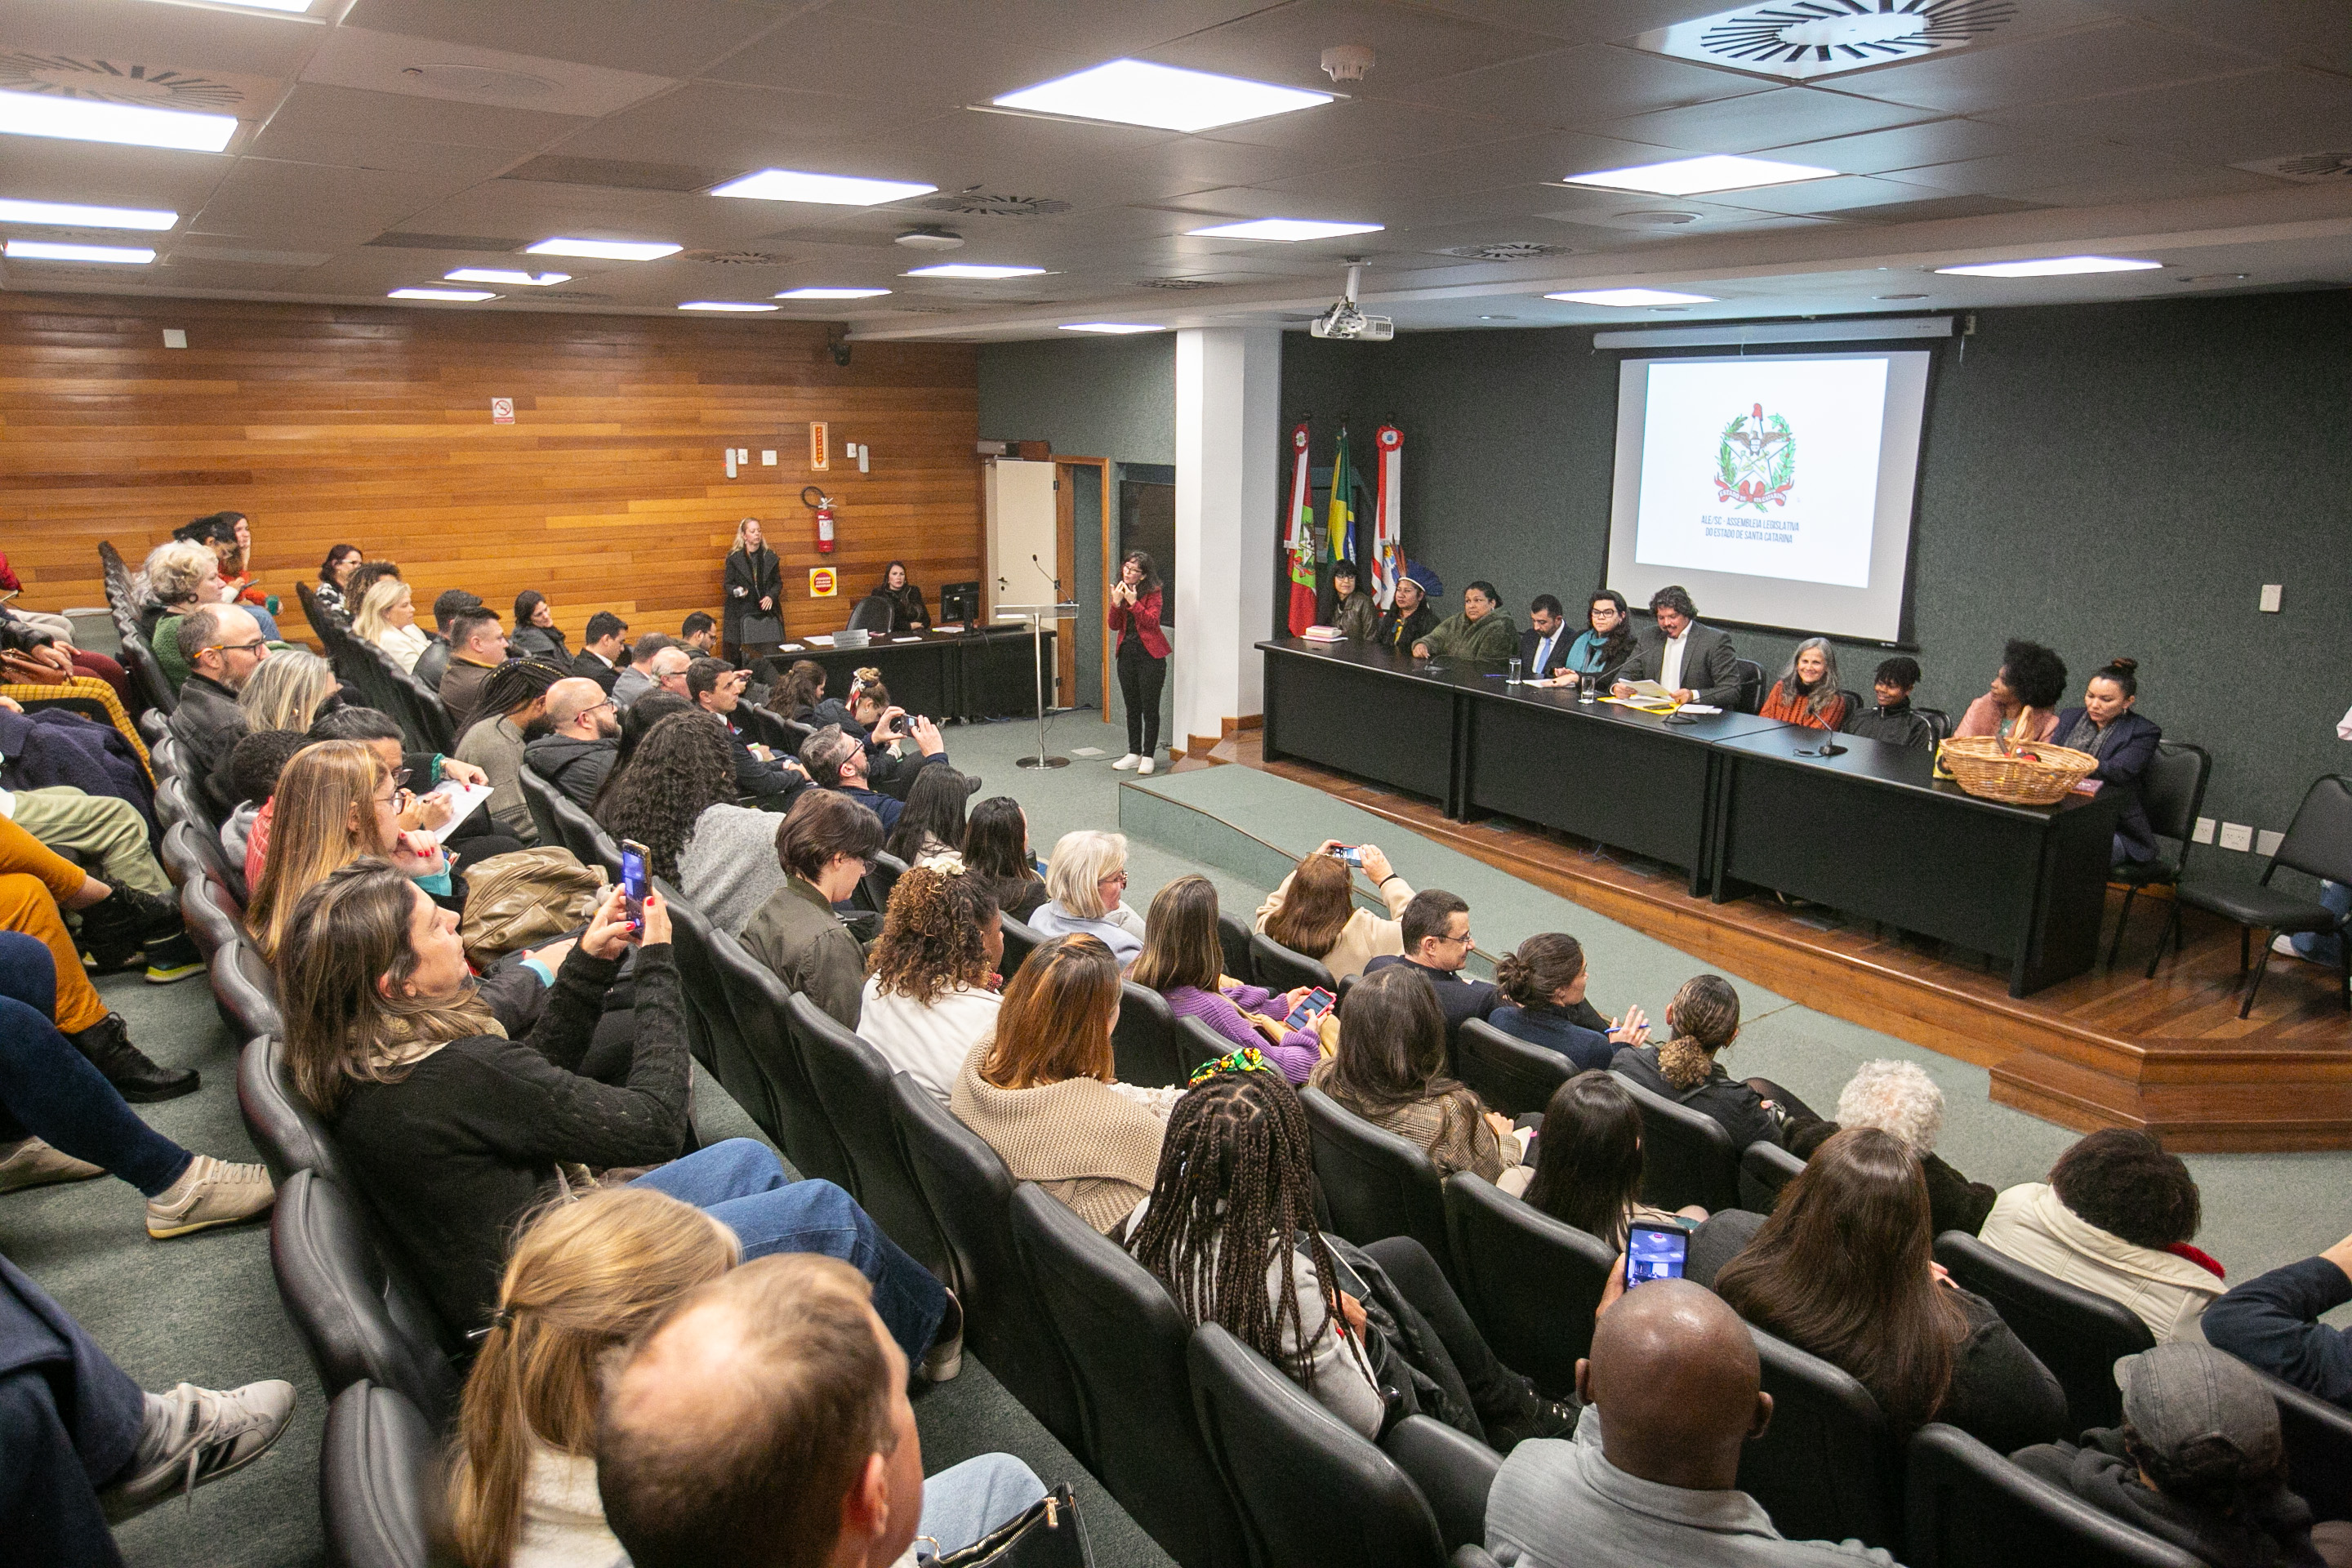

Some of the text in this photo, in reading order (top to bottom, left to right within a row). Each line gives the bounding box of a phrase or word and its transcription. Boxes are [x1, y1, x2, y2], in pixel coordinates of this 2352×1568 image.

[1701, 515, 1722, 525] ALE/SC
[1726, 517, 1762, 528] ASSEMBLEIA
[1763, 519, 1799, 532] LEGISLATIVA
[1705, 527, 1793, 543] DO ESTADO DE SANTA CATARINA
